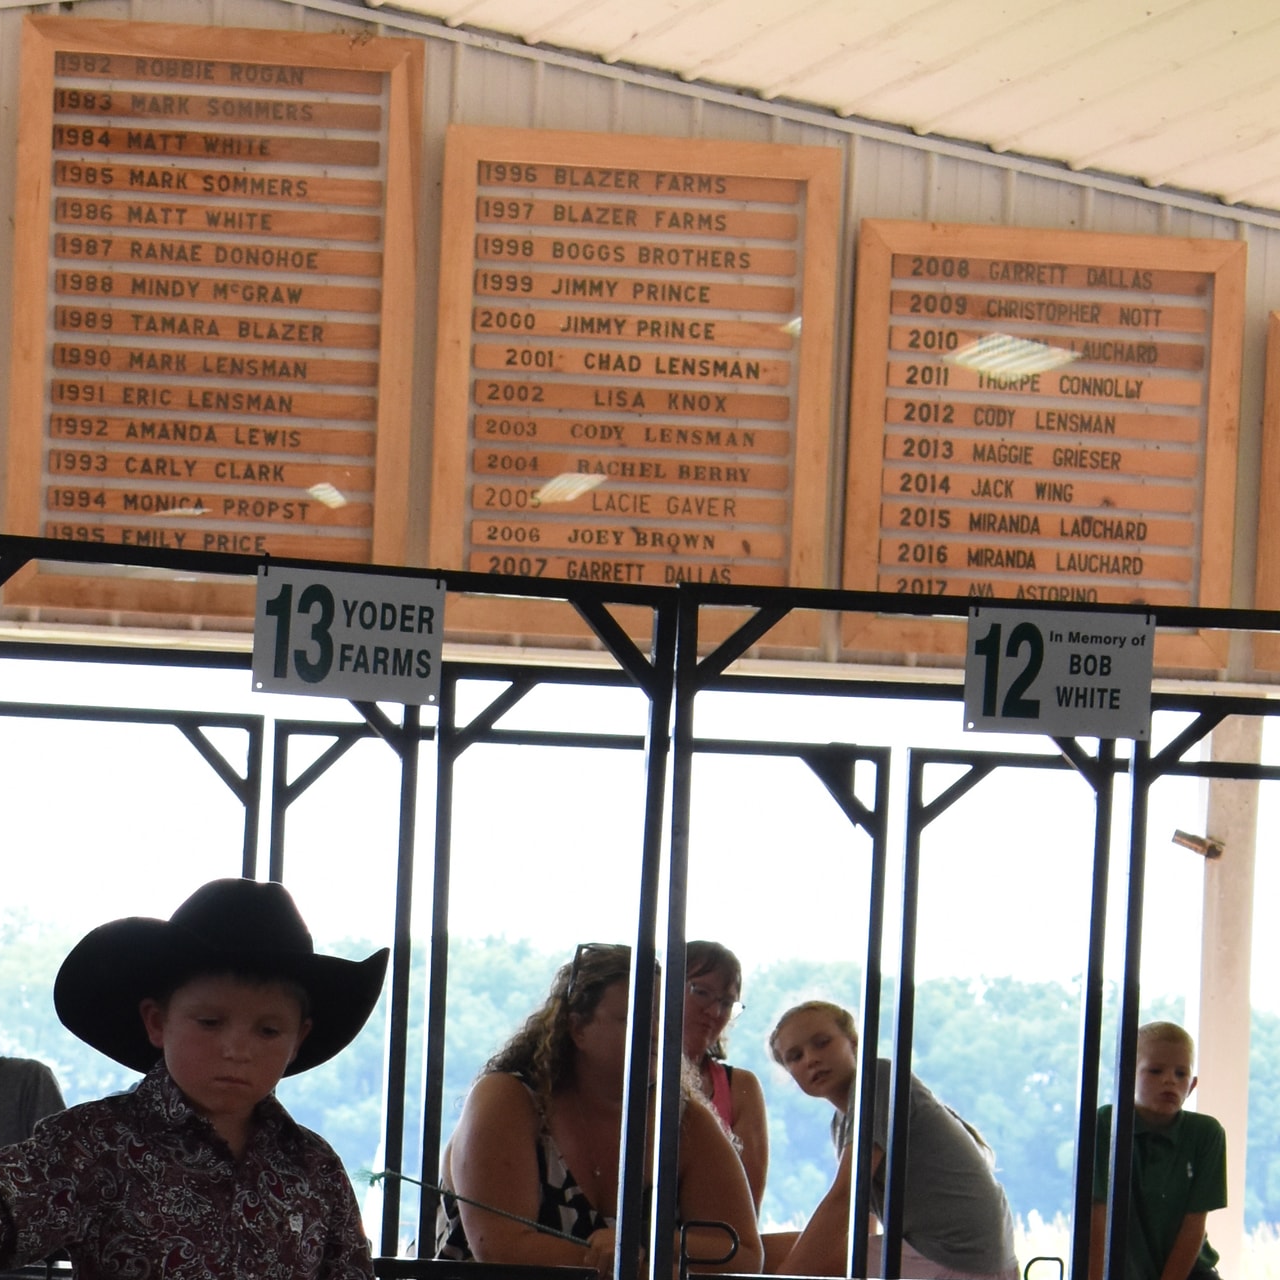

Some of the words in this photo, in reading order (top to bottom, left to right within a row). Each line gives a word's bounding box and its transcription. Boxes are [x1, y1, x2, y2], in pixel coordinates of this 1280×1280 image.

[60, 167, 114, 186] 1985
[129, 170, 187, 190] MARK
[203, 174, 308, 197] SOMMERS
[483, 166, 537, 182] 1996
[555, 168, 640, 189] BLAZER
[656, 173, 726, 194] FARMS
[59, 203, 113, 222] 1986
[127, 206, 185, 226] MATT
[206, 211, 272, 231] WHITE
[482, 202, 534, 219] 1997
[554, 203, 638, 225] BLAZER
[655, 211, 726, 231] FARMS
[59, 239, 111, 256] 1987
[130, 242, 202, 263] RANAE
[215, 247, 318, 269] DONOHOE
[483, 238, 534, 257] 1998
[553, 241, 625, 262] BOGGS
[638, 247, 751, 268] BROTHERS
[60, 275, 113, 292] 1988
[131, 277, 199, 298] MINDY
[481, 273, 533, 292] 1999
[551, 278, 618, 297] JIMMY
[634, 283, 711, 303] PRINCE
[912, 258, 970, 277] 2008
[990, 262, 1068, 285] GARRETT
[1088, 268, 1152, 289] DALLAS
[910, 296, 968, 315] 2009
[987, 300, 1100, 324] CHRISTOPHER
[1119, 307, 1161, 326] NOTT
[60, 312, 113, 329] 1989
[131, 314, 220, 337] TAMARA
[238, 320, 323, 342] BLAZER
[480, 312, 535, 330] 2000
[560, 315, 626, 335] JIMMY
[637, 320, 715, 340] PRINCE
[59, 348, 111, 366] 1990
[128, 350, 187, 371] MARK
[203, 356, 307, 379] LENSMAN
[505, 350, 554, 368] 2001
[584, 352, 641, 372] CHAD
[656, 357, 760, 379] LENSMAN
[906, 366, 949, 386] 2011
[1059, 375, 1143, 399] CONNOLLY
[58, 384, 105, 403] 1991
[122, 387, 172, 406] ERIC
[188, 392, 292, 413] LENSMAN
[488, 384, 545, 402] 2002
[594, 390, 645, 408] LISA
[668, 393, 727, 413] KNOX
[56, 418, 109, 437] 1992
[126, 421, 217, 443] AMANDA
[235, 426, 301, 447] LEWIS
[904, 403, 954, 422] 2012
[974, 408, 1015, 428] CODY
[1035, 411, 1116, 433] LENSMAN
[486, 419, 537, 437] 2003
[571, 424, 625, 441] CODY
[645, 427, 756, 448] LENSMAN
[55, 453, 108, 472] 1993
[125, 456, 196, 477] CARLY
[215, 461, 284, 482] CLARK
[487, 454, 539, 472] 2004
[577, 458, 666, 479] RACHEL
[679, 463, 751, 483] BERRY
[903, 438, 953, 459] 2013
[973, 443, 1033, 465] MAGGIE
[1052, 447, 1122, 470] GRIESER
[900, 474, 951, 493] 2014
[972, 478, 1013, 498] JACK
[1035, 482, 1073, 503] WING
[53, 489, 107, 508] 1994
[224, 496, 309, 520] PROPST
[487, 525, 540, 542] 2006
[568, 528, 624, 546] JOEY
[634, 528, 715, 550] BROWN
[900, 509, 951, 528] 2015
[969, 512, 1040, 535] MIRANDA
[1060, 516, 1147, 541] LAUCHARD
[489, 556, 547, 577] 2007
[567, 560, 645, 582] GARRETT
[665, 564, 731, 585] DALLAS
[898, 544, 948, 564] 2016
[968, 547, 1036, 570] MIRANDA
[1056, 553, 1143, 575] LAUCHARD
[897, 579, 947, 594] 2017
[342, 600, 435, 634] YODER
[266, 584, 335, 684] 13
[1050, 631, 1063, 643] In
[1068, 632, 1126, 648] Memory
[1131, 634, 1146, 646] of
[339, 644, 431, 679] FARMS
[975, 622, 1044, 719] 12
[1069, 654, 1111, 676] BOB
[1056, 686, 1121, 709] WHITE
